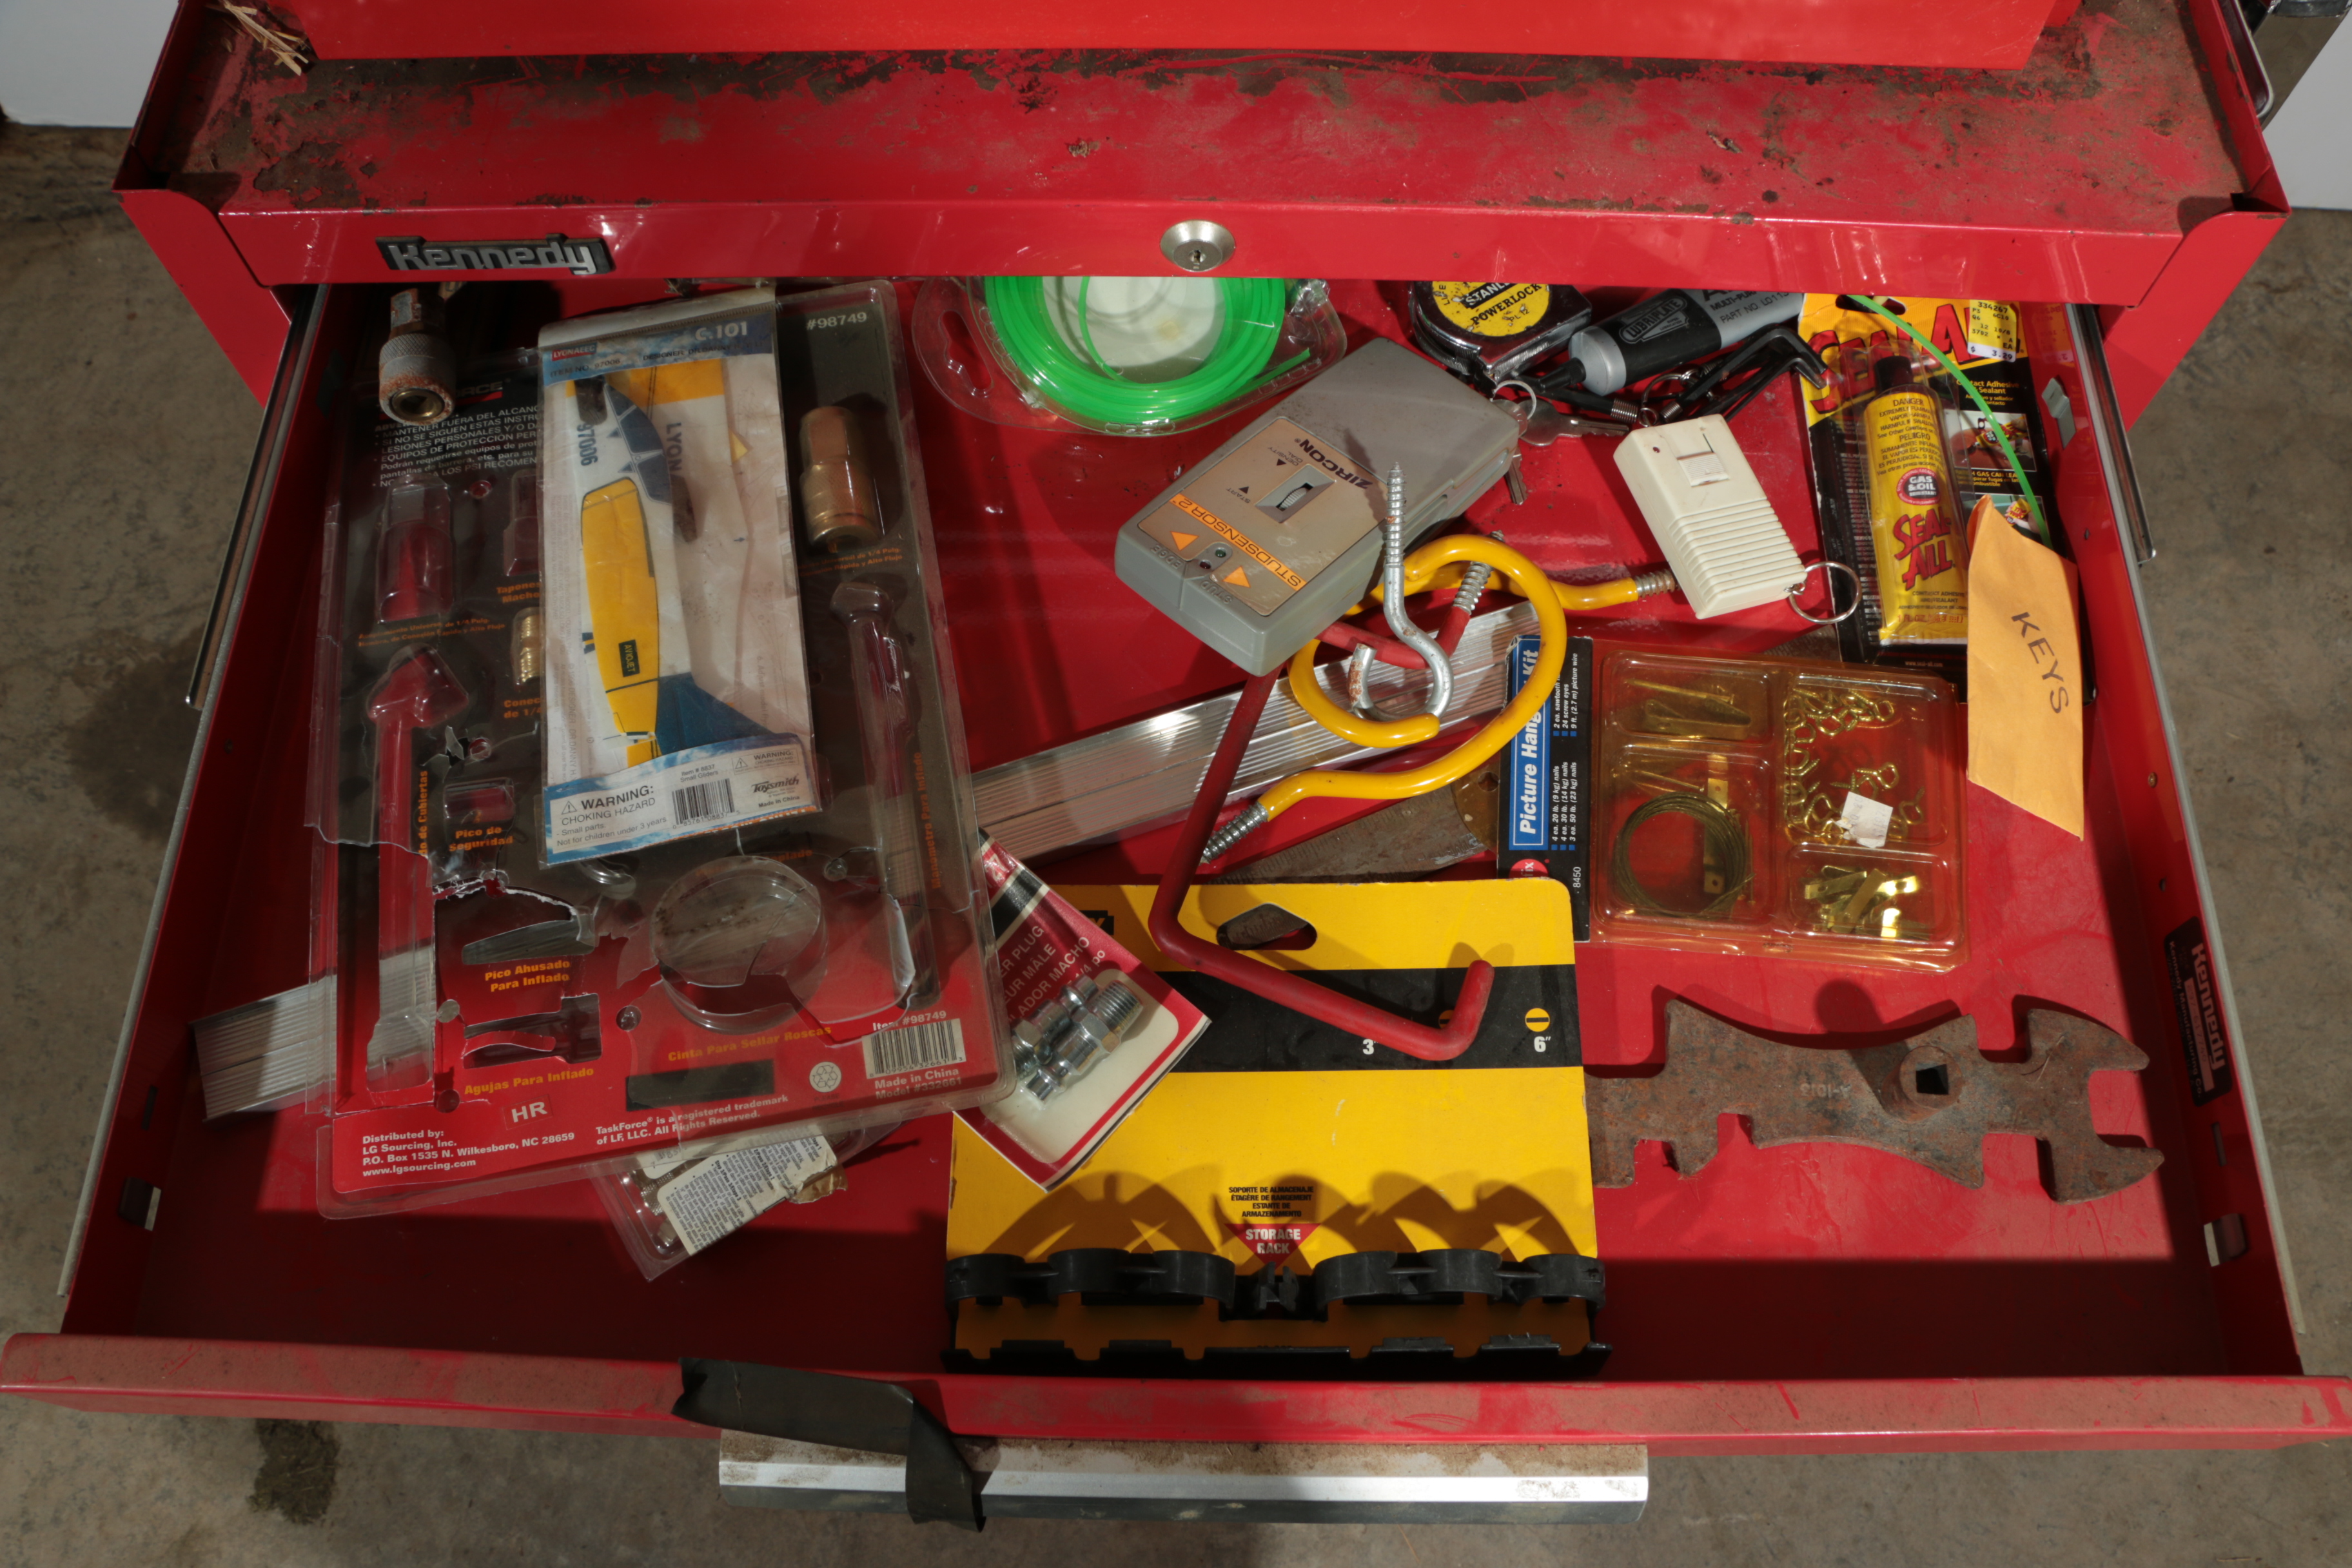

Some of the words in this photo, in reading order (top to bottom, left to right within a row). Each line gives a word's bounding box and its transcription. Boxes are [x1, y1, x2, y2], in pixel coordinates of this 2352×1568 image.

[387, 241, 596, 275] Kennedy
[1471, 284, 1542, 324] POWERLOCK
[1720, 309, 1743, 323] PART
[1745, 304, 1761, 314] NO.
[1977, 301, 2008, 313] 334267
[807, 311, 868, 331] #98749
[1625, 299, 1681, 337] LUBRIPLATE
[695, 321, 749, 341] C.101
[1992, 349, 2013, 360] 3.29
[394, 436, 411, 444] NO
[428, 426, 468, 439] SIGUEN
[469, 419, 502, 430] ESTAS
[441, 416, 474, 428] FUERA
[381, 449, 427, 462] EQUIPOS
[446, 433, 513, 451] PROTECCIÓN
[382, 440, 432, 454] LESIONES
[434, 426, 501, 445] PERSONALES
[504, 423, 525, 433] Y/O
[380, 460, 413, 471] Podrán
[416, 451, 462, 466] requerirse
[464, 444, 501, 456] equipos
[1267, 446, 1300, 467] DENSITY
[1288, 451, 1304, 464] DIAL
[380, 467, 420, 480] pantallas
[442, 466, 462, 476] LOS
[1225, 487, 1251, 504] START
[1152, 544, 1184, 570] EDGE
[1191, 506, 1302, 587] STUDSENSOR
[1200, 580, 1233, 605] STUD
[623, 644, 636, 673] AVIOJET
[1522, 649, 1538, 675] Kit
[2011, 611, 2070, 714] KEYS
[503, 710, 520, 718] de
[1562, 720, 1569, 729] 24
[753, 751, 794, 761] WARNING:
[680, 774, 697, 783] Small
[698, 770, 718, 779] Gliders
[681, 769, 694, 777] Item
[912, 752, 925, 790] Inflado
[751, 774, 799, 793] Toysmith
[418, 770, 428, 823] Cubiertas
[581, 785, 654, 810] WARNING:
[921, 792, 932, 821] Para
[1519, 763, 1538, 834] Picture
[562, 810, 612, 826] CHOKING
[614, 798, 656, 817] HAZARD
[1552, 814, 1559, 823] 20
[1561, 814, 1568, 823] 30
[1569, 814, 1576, 823] 50
[455, 828, 483, 839] Pico
[486, 826, 502, 834] de
[562, 827, 583, 836] Small
[584, 830, 614, 841] children
[617, 825, 638, 836] under
[647, 816, 667, 829] years
[449, 836, 514, 852] Seguridad
[1573, 867, 1582, 888] 8450
[1011, 925, 1045, 961] PLUG
[1022, 943, 1057, 980] MÂLE
[1049, 936, 1090, 983] MACHO
[1091, 949, 1106, 967] po
[484, 970, 511, 981] Pico
[514, 959, 571, 975] Ahusado
[490, 981, 520, 992] Para
[523, 972, 571, 986] Inflado
[2169, 941, 2182, 990] Kennedy
[2179, 992, 2199, 1075] Manufacturing
[2191, 942, 2226, 1071] Kennedy
[902, 1010, 946, 1026] #98749
[668, 1048, 704, 1062] Cinta
[707, 1042, 738, 1055] Para
[740, 1035, 780, 1050] Sellar
[783, 1026, 832, 1041] Roscas
[464, 1080, 509, 1095] Agujas
[513, 1075, 546, 1088] Para
[547, 1067, 594, 1083] Inflado
[874, 1077, 908, 1090] Made
[910, 1073, 921, 1083] in
[924, 1068, 959, 1081] China
[875, 1088, 910, 1100] Model
[913, 1076, 962, 1092] #332661
[511, 1101, 548, 1123] HR
[656, 1116, 666, 1125] is
[678, 1104, 731, 1122] registered
[734, 1095, 789, 1112] trademark
[362, 1130, 425, 1144] Distributed
[427, 1129, 444, 1139] by:
[596, 1137, 609, 1146] of
[610, 1133, 625, 1144] LF,
[627, 1129, 652, 1140] LLC.
[654, 1125, 669, 1135] All
[672, 1120, 707, 1133] Rights
[709, 1112, 761, 1127] Reserved.
[362, 1146, 378, 1155] LG
[380, 1141, 434, 1153] Sourcing,
[436, 1139, 458, 1148] Inc.
[362, 1155, 384, 1166] P.O.
[387, 1153, 408, 1163] Box
[411, 1151, 439, 1161] 1535
[441, 1149, 454, 1159] N.
[456, 1141, 520, 1157] Wilkesboro,
[522, 1137, 539, 1148] NC
[542, 1132, 575, 1144] 28659
[362, 1159, 476, 1177] www.lgsourcing.com
[1245, 1228, 1301, 1240] STORAGE
[1257, 1242, 1290, 1254] RACK
